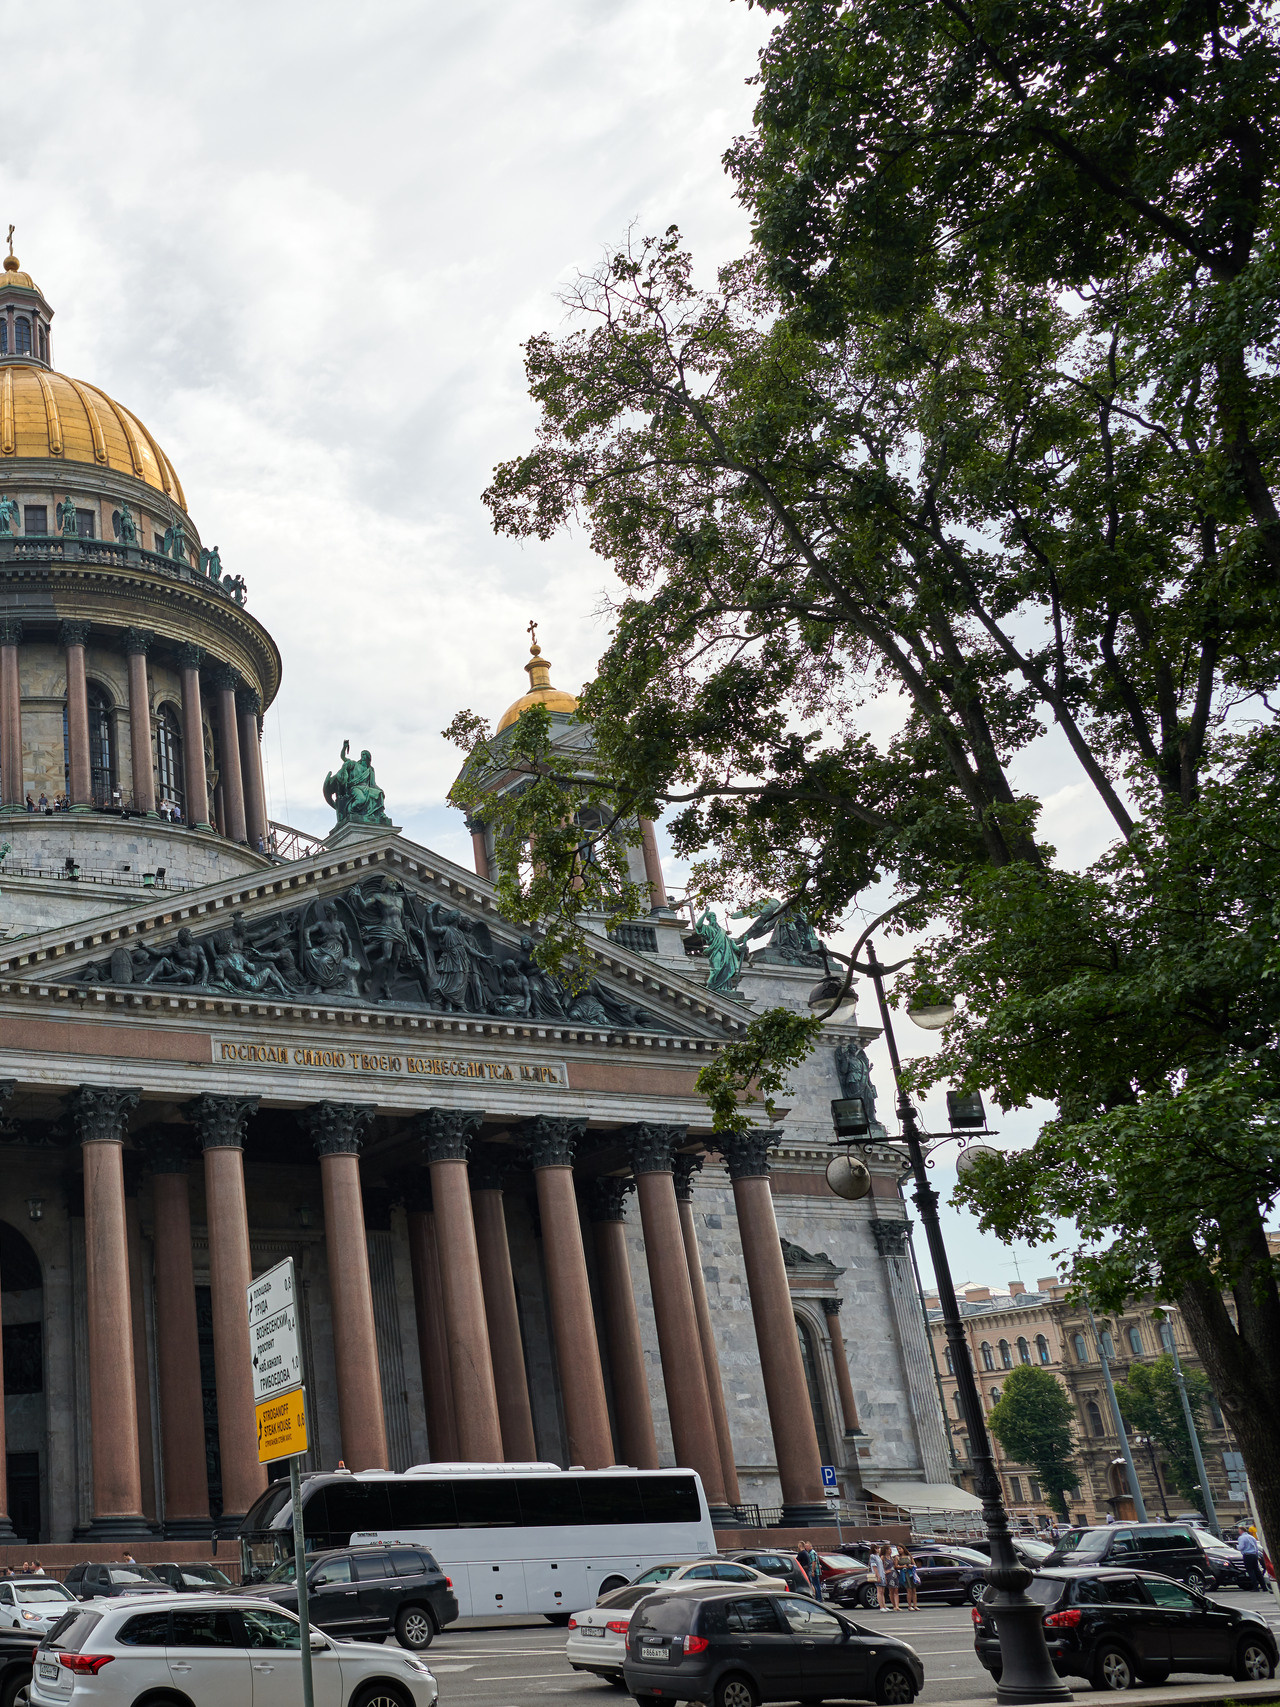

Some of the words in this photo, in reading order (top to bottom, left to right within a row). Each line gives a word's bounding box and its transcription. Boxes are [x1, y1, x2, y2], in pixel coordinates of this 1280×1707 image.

[221, 1043, 288, 1064] ГОСПОДИ
[294, 1049, 346, 1068] СИЛОЮ
[349, 1053, 402, 1072] ТВОЕЮ
[254, 1282, 272, 1299] площадь
[255, 1299, 268, 1316] ТРУДА
[256, 1310, 287, 1340] ВОЗНЕСЕНСКИЙ
[287, 1317, 295, 1332] 0,4
[257, 1338, 275, 1356] проспект
[260, 1368, 291, 1391] ГРИБОЕДОВА
[263, 1403, 288, 1422] STROGANOFF
[264, 1423, 277, 1437] STEAK
[277, 1418, 291, 1433] HOUSE
[297, 1412, 305, 1429] 0,6
[824, 1468, 833, 1484] P
